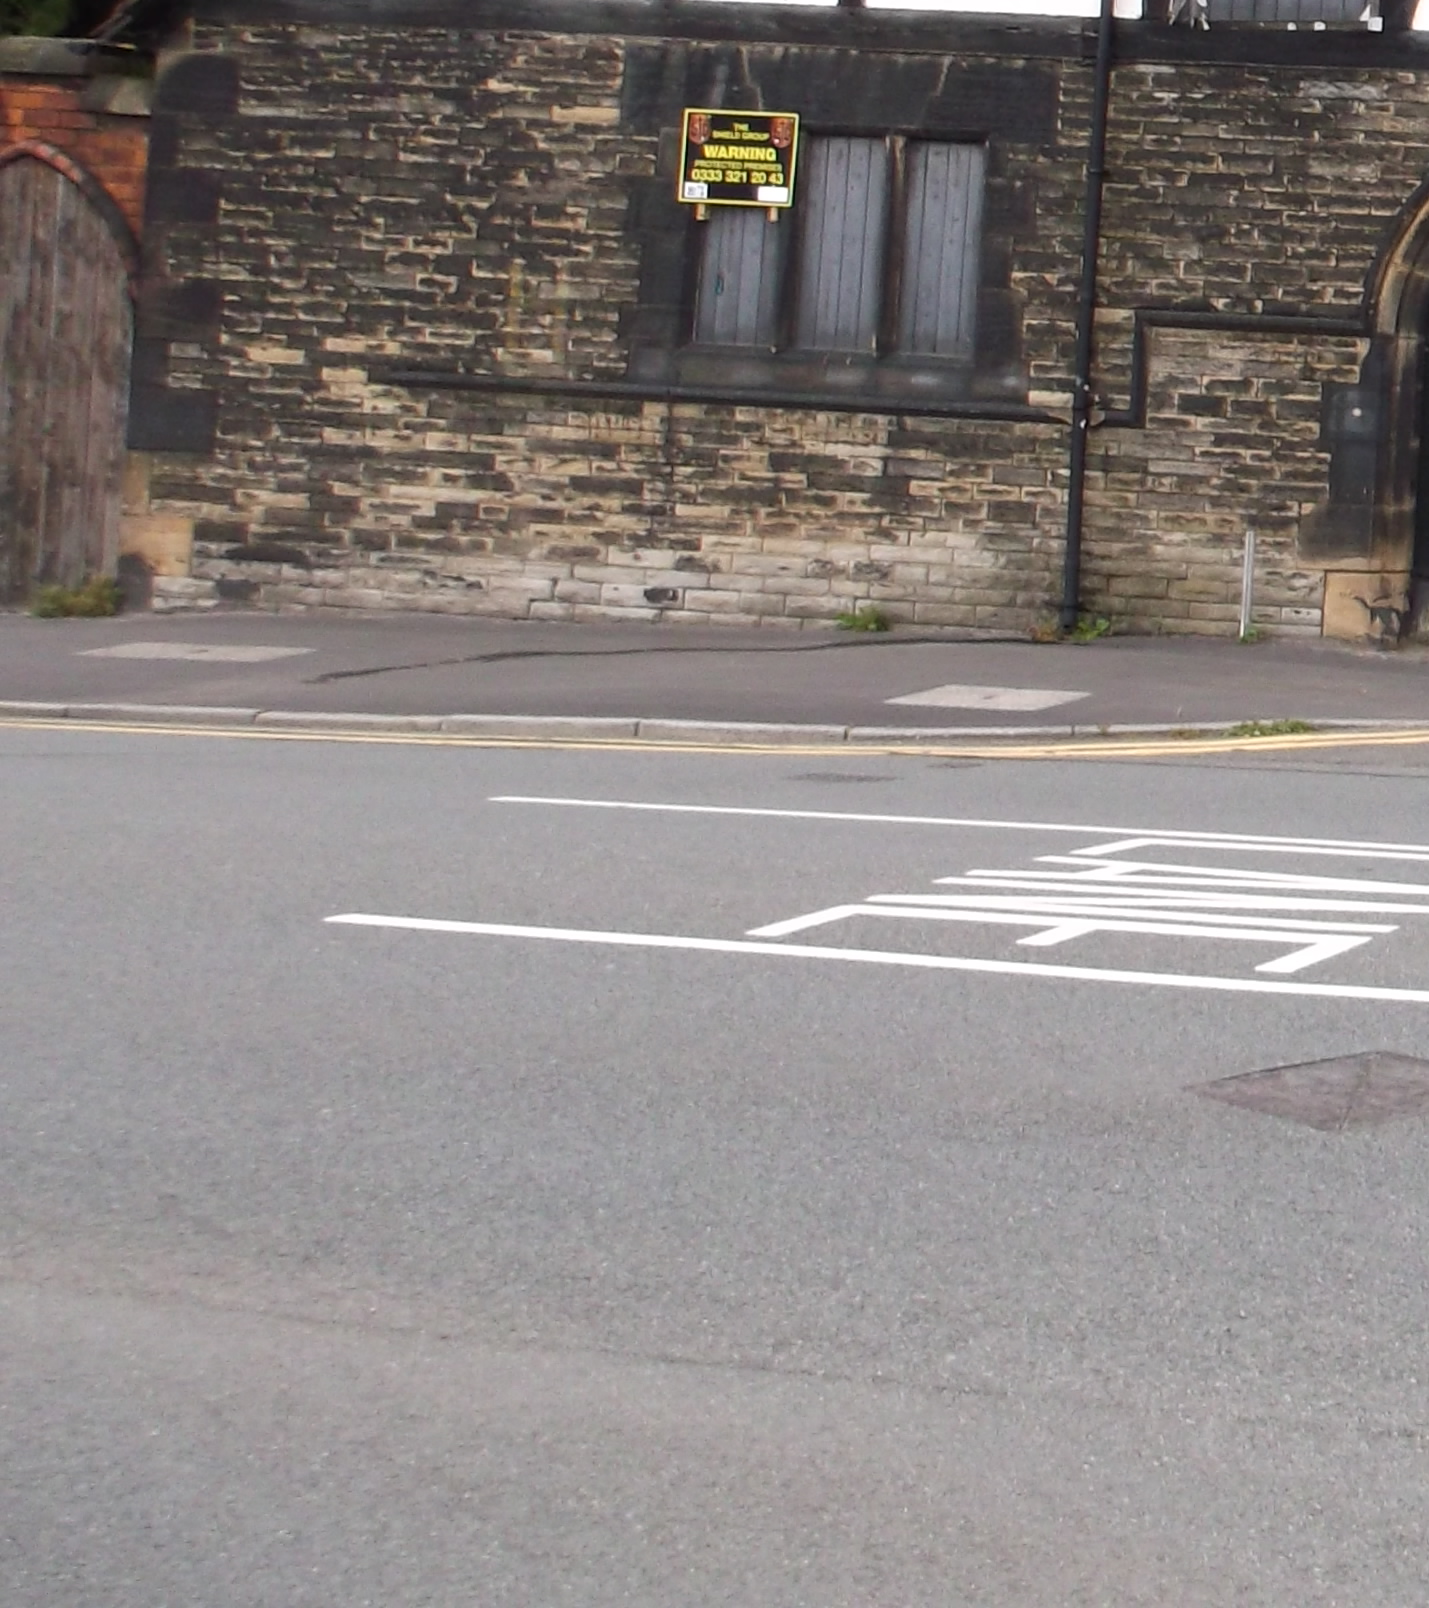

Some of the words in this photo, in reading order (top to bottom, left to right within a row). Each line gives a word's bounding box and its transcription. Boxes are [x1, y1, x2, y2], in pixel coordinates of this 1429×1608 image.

[742, 132, 770, 141] GROUP
[703, 145, 777, 161] WARNING
[691, 169, 722, 182] 0333
[725, 171, 747, 183] 321
[750, 172, 766, 184] 20
[768, 173, 784, 185] 43
